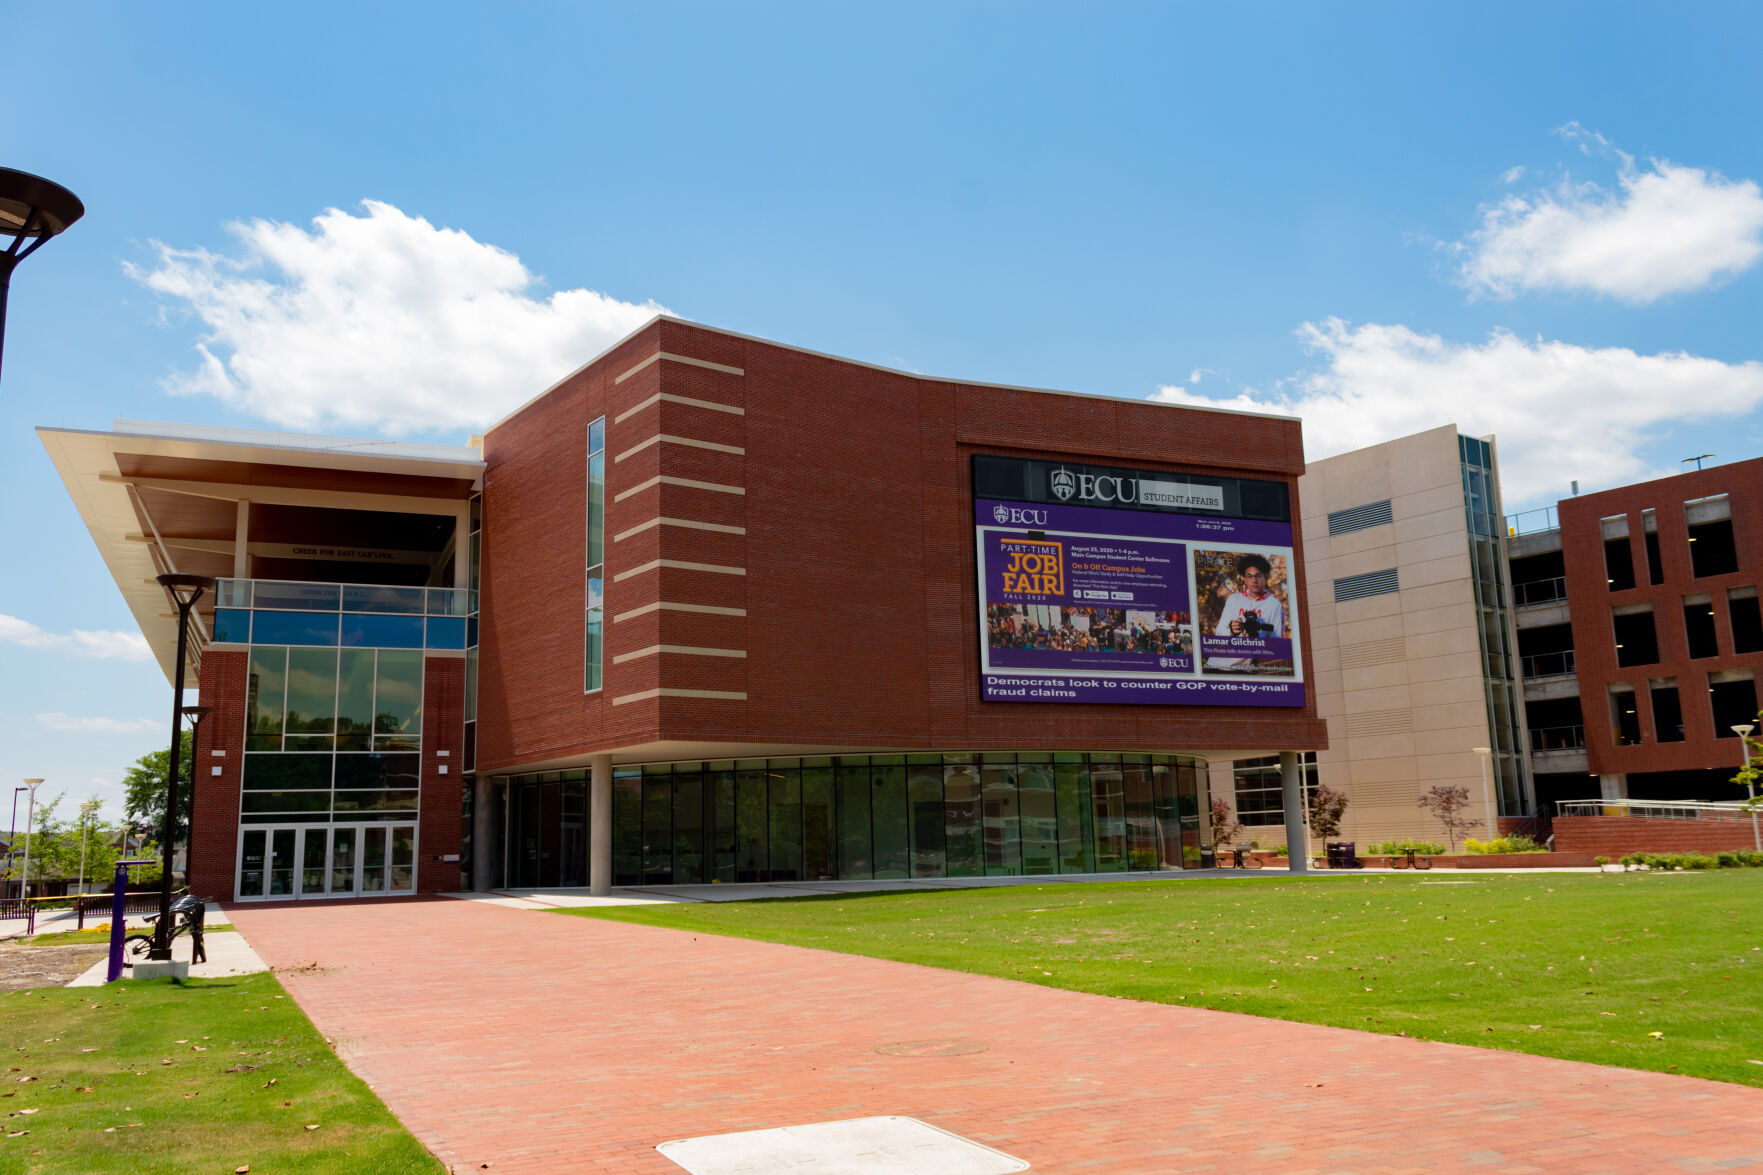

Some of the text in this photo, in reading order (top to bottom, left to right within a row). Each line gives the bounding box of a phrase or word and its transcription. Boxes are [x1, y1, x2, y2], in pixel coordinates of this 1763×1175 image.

[1077, 473, 1137, 503] ECU
[1144, 492, 1219, 506] STUDENT AFFAIRS
[1010, 508, 1048, 525] ECU
[293, 547, 317, 555] CHEER
[1000, 543, 1057, 555] PART-TIME
[1071, 545, 1089, 553] August
[1085, 552, 1106, 560] Campus
[1107, 553, 1127, 561] Student
[1197, 556, 1233, 567] PIRATE
[1007, 552, 1058, 574] JOB
[1102, 564, 1129, 573] Campus
[1130, 565, 1146, 574] Jobs
[1002, 572, 1061, 595] FAIR
[1203, 636, 1265, 647] Lamar Gilchrist
[1168, 658, 1189, 668] ECU
[987, 676, 1289, 693] Democrats look to counter GOP vote-by-mail
[987, 687, 1076, 698] fraud claims
